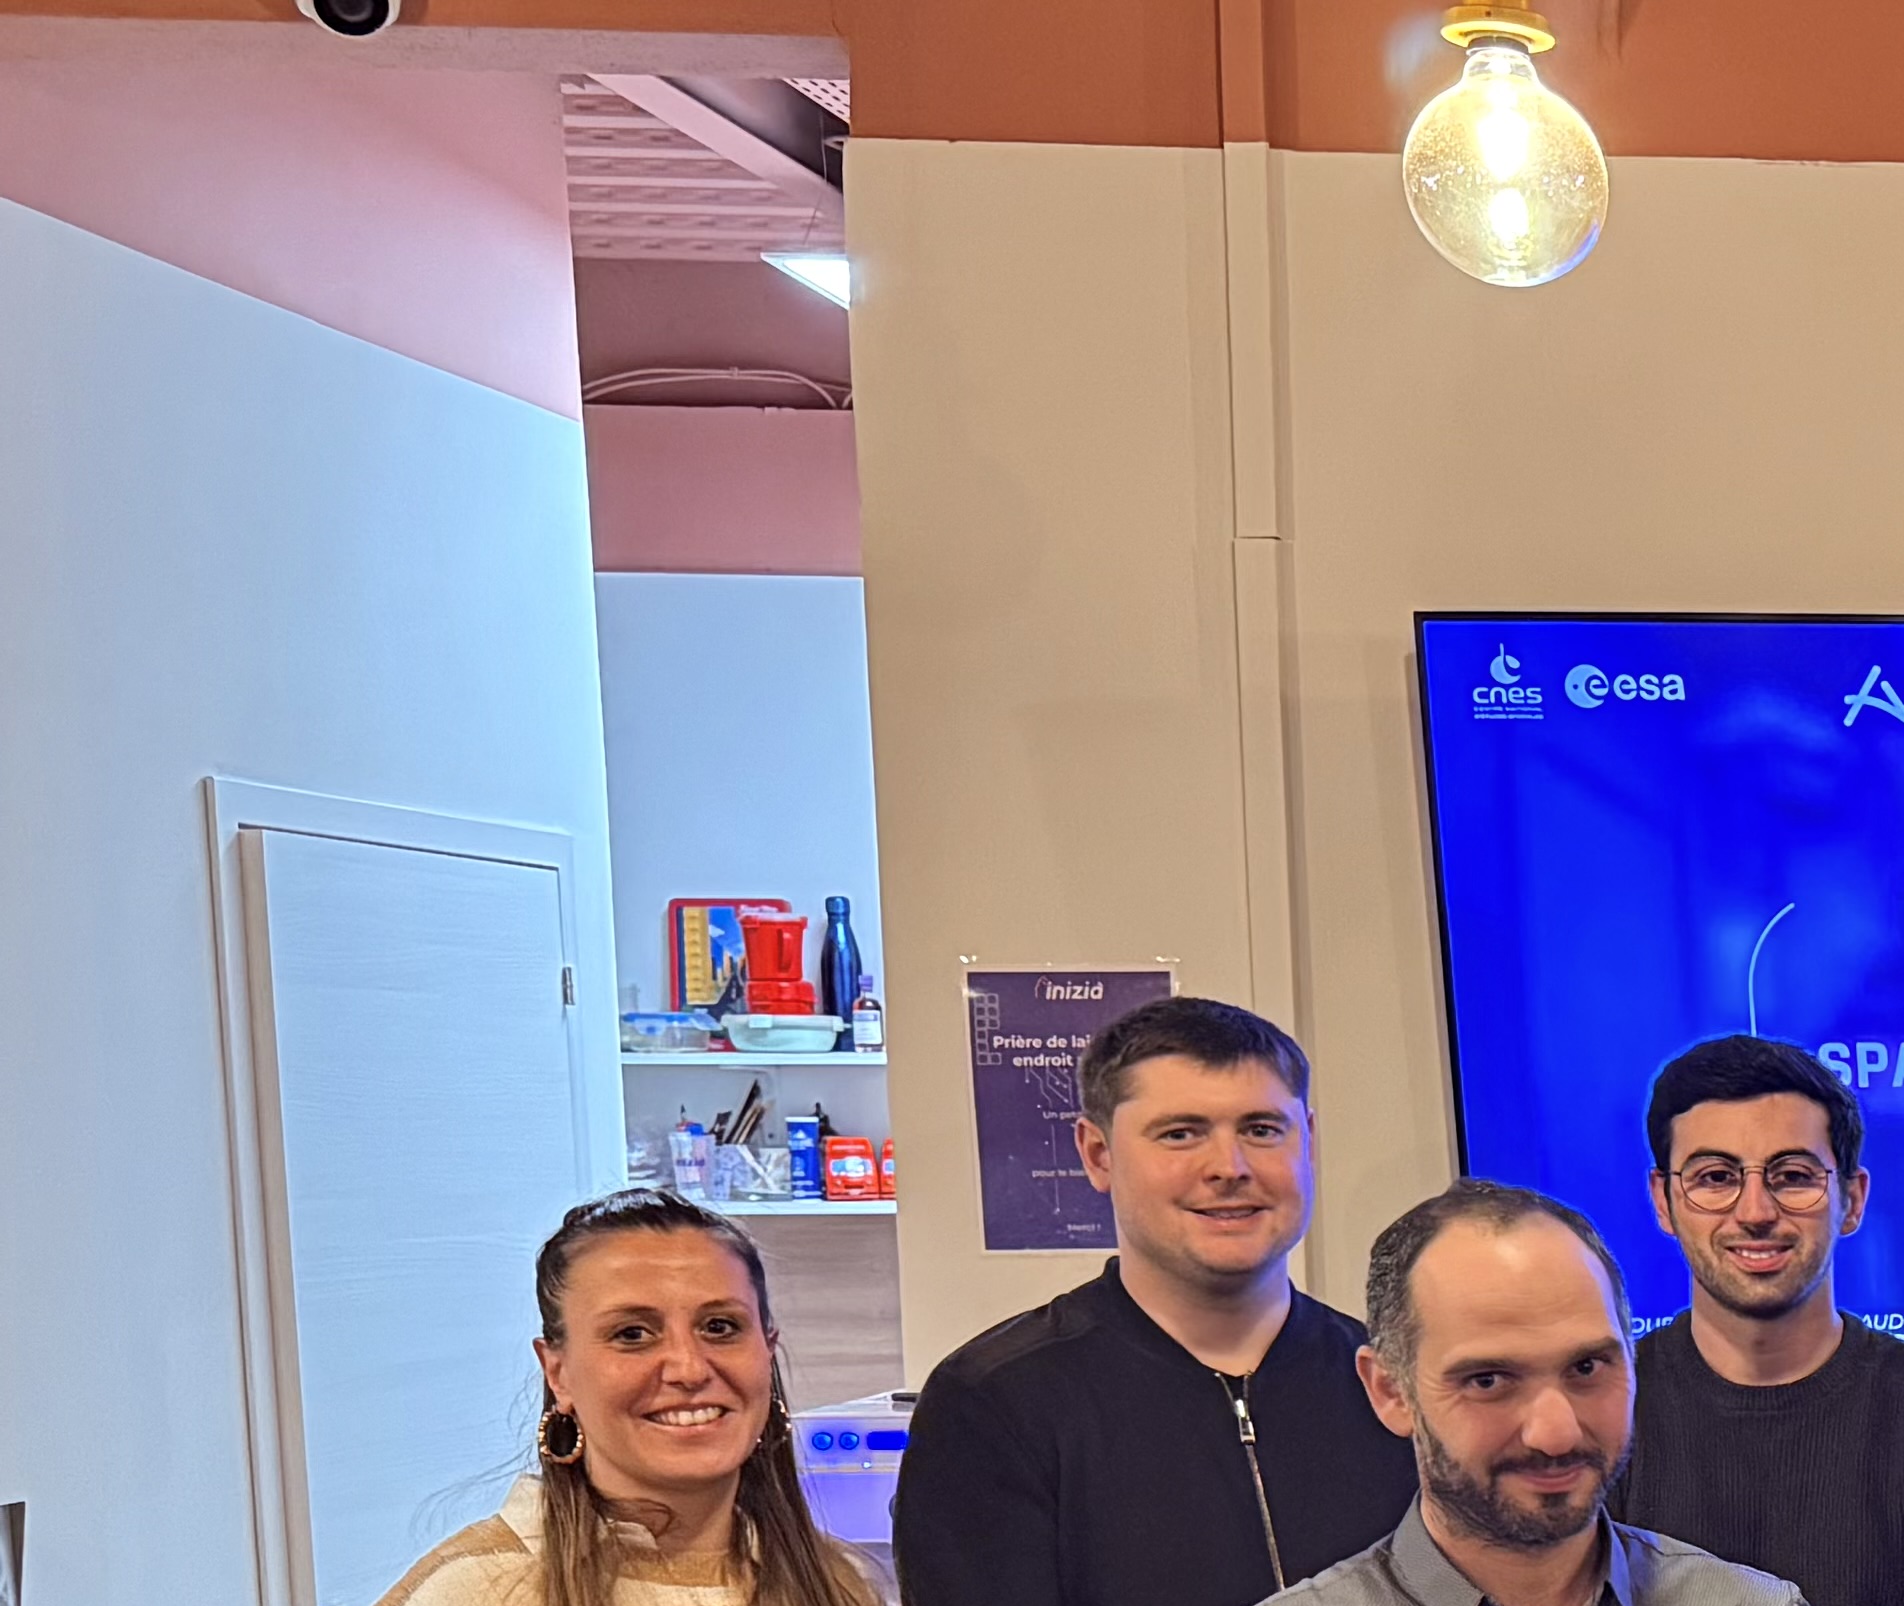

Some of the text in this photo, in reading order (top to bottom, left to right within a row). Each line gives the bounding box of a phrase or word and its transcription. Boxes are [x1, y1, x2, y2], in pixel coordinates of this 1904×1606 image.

[1613, 674, 1686, 700] esa
[1472, 687, 1543, 704] cnes
[993, 1034, 1043, 1049] Prière
[1046, 1034, 1068, 1049] de
[1012, 1052, 1075, 1067] endroit
